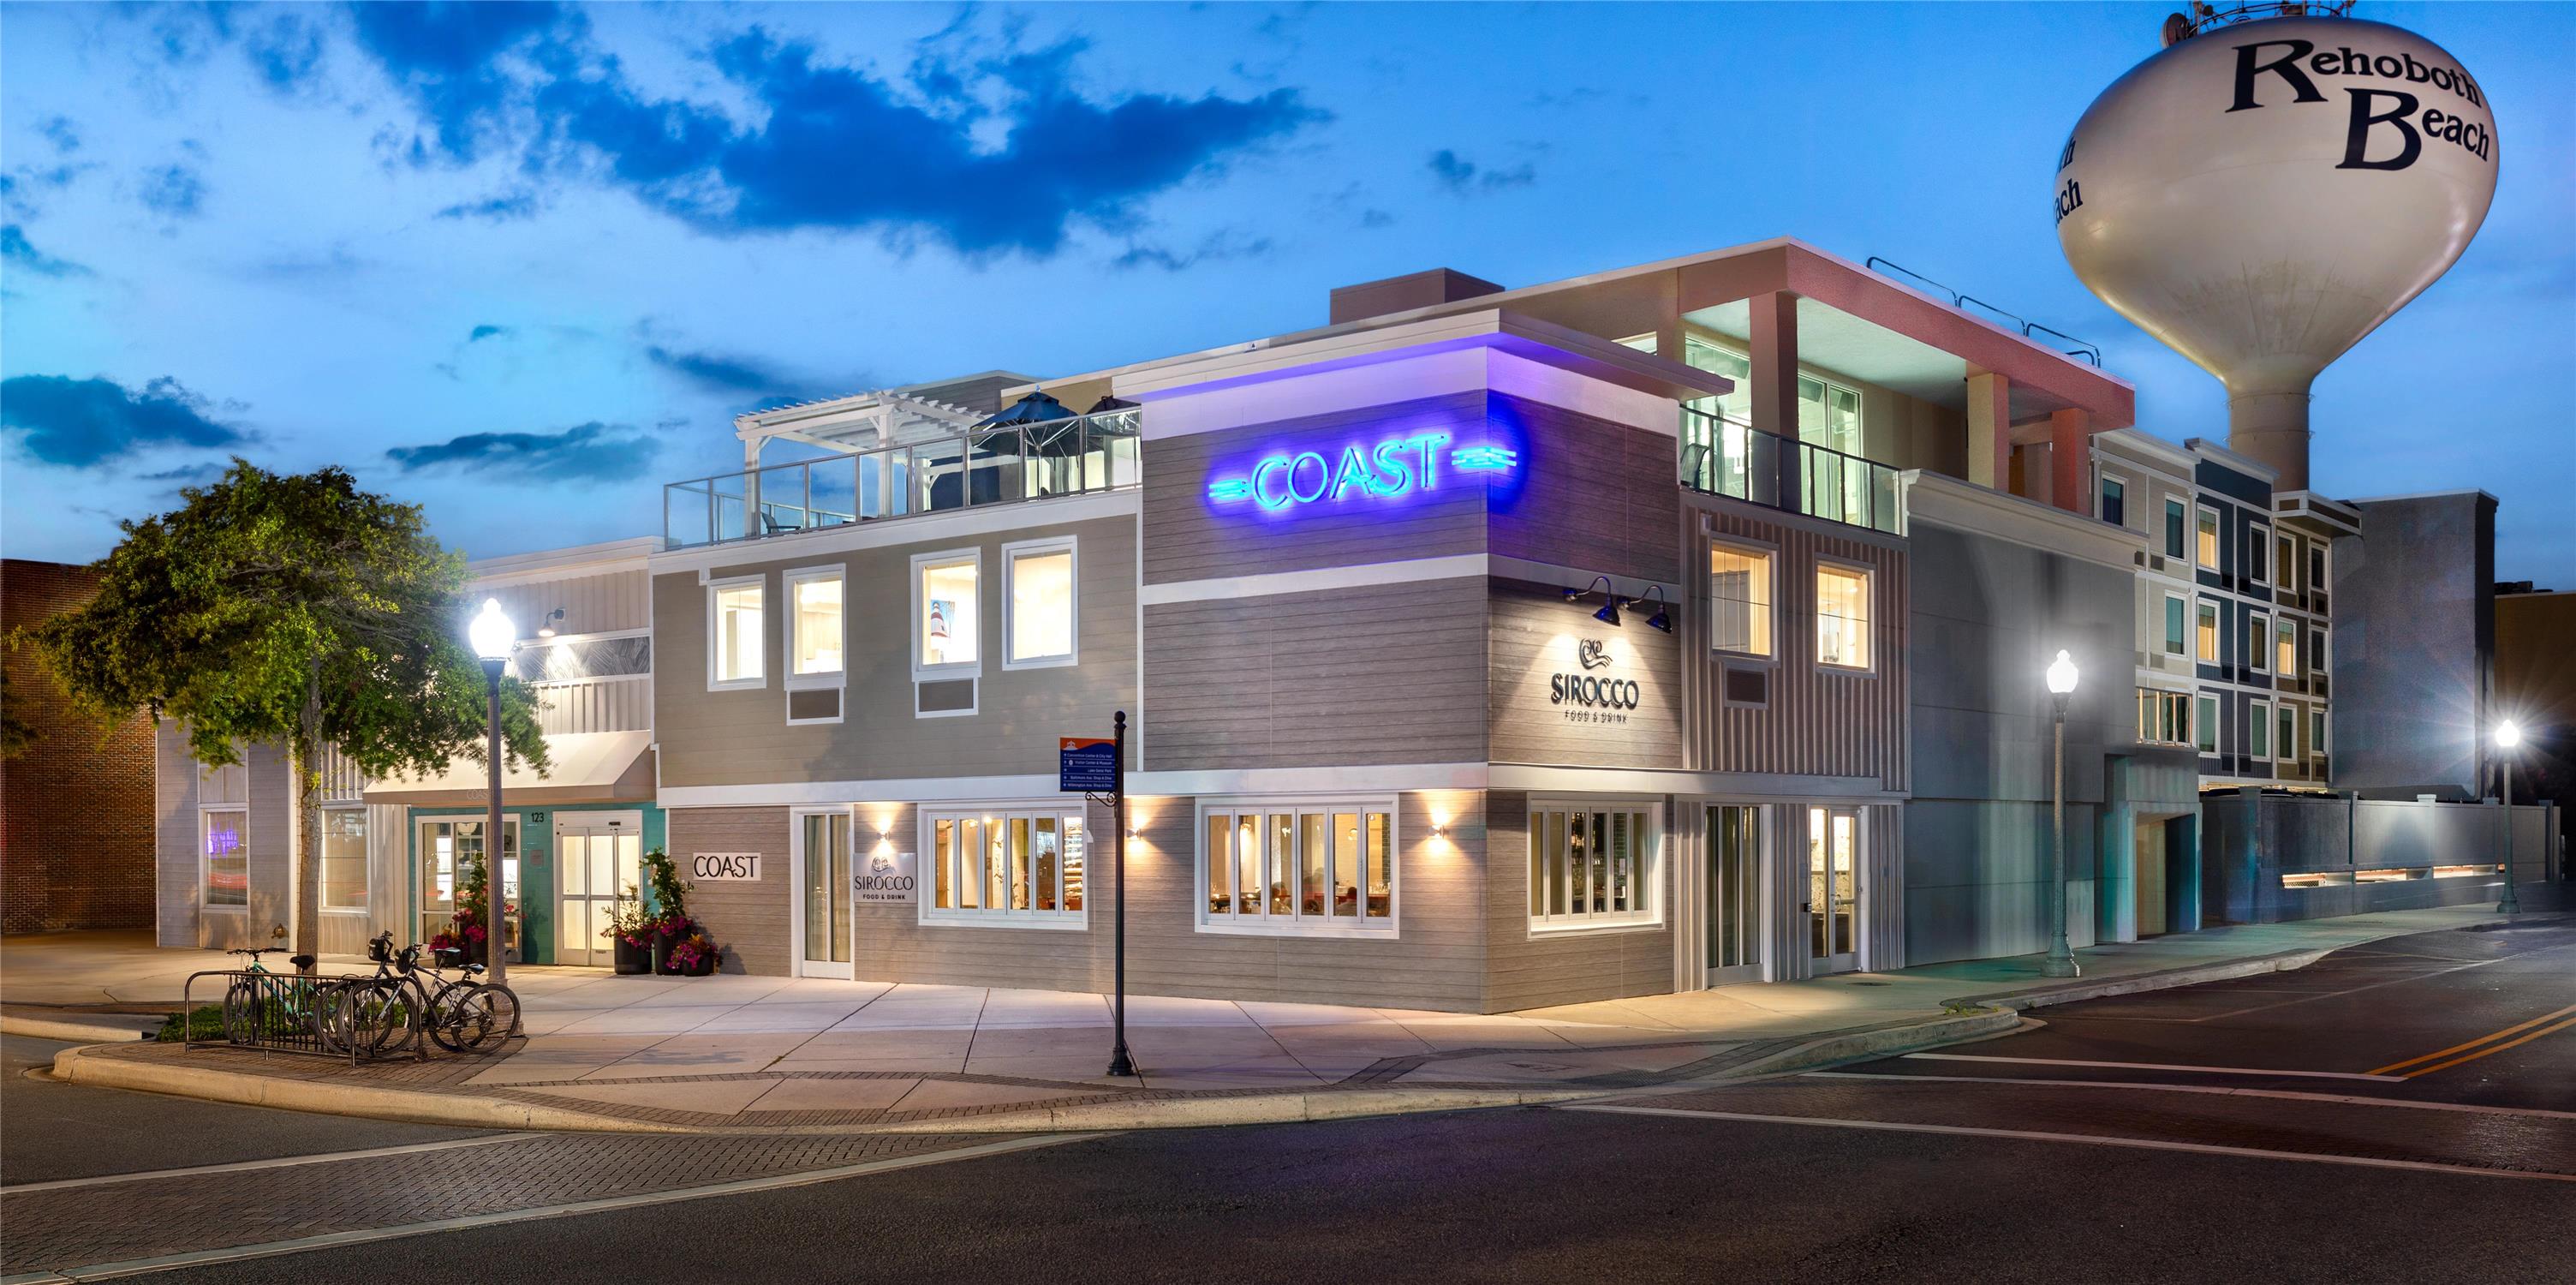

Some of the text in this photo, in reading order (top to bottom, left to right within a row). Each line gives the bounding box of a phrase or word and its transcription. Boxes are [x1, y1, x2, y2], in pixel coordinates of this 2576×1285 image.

[2225, 39, 2482, 113] Rehoboth
[2335, 87, 2488, 171] Beach
[1250, 433, 1450, 511] COAST
[1551, 672, 1639, 710] SIROCCO
[1565, 710, 1628, 724] FOOD & DRINK
[466, 789, 489, 800] COAS
[531, 812, 544, 822] 123
[694, 856, 758, 878] COAST
[855, 876, 914, 891] SIROCCO
